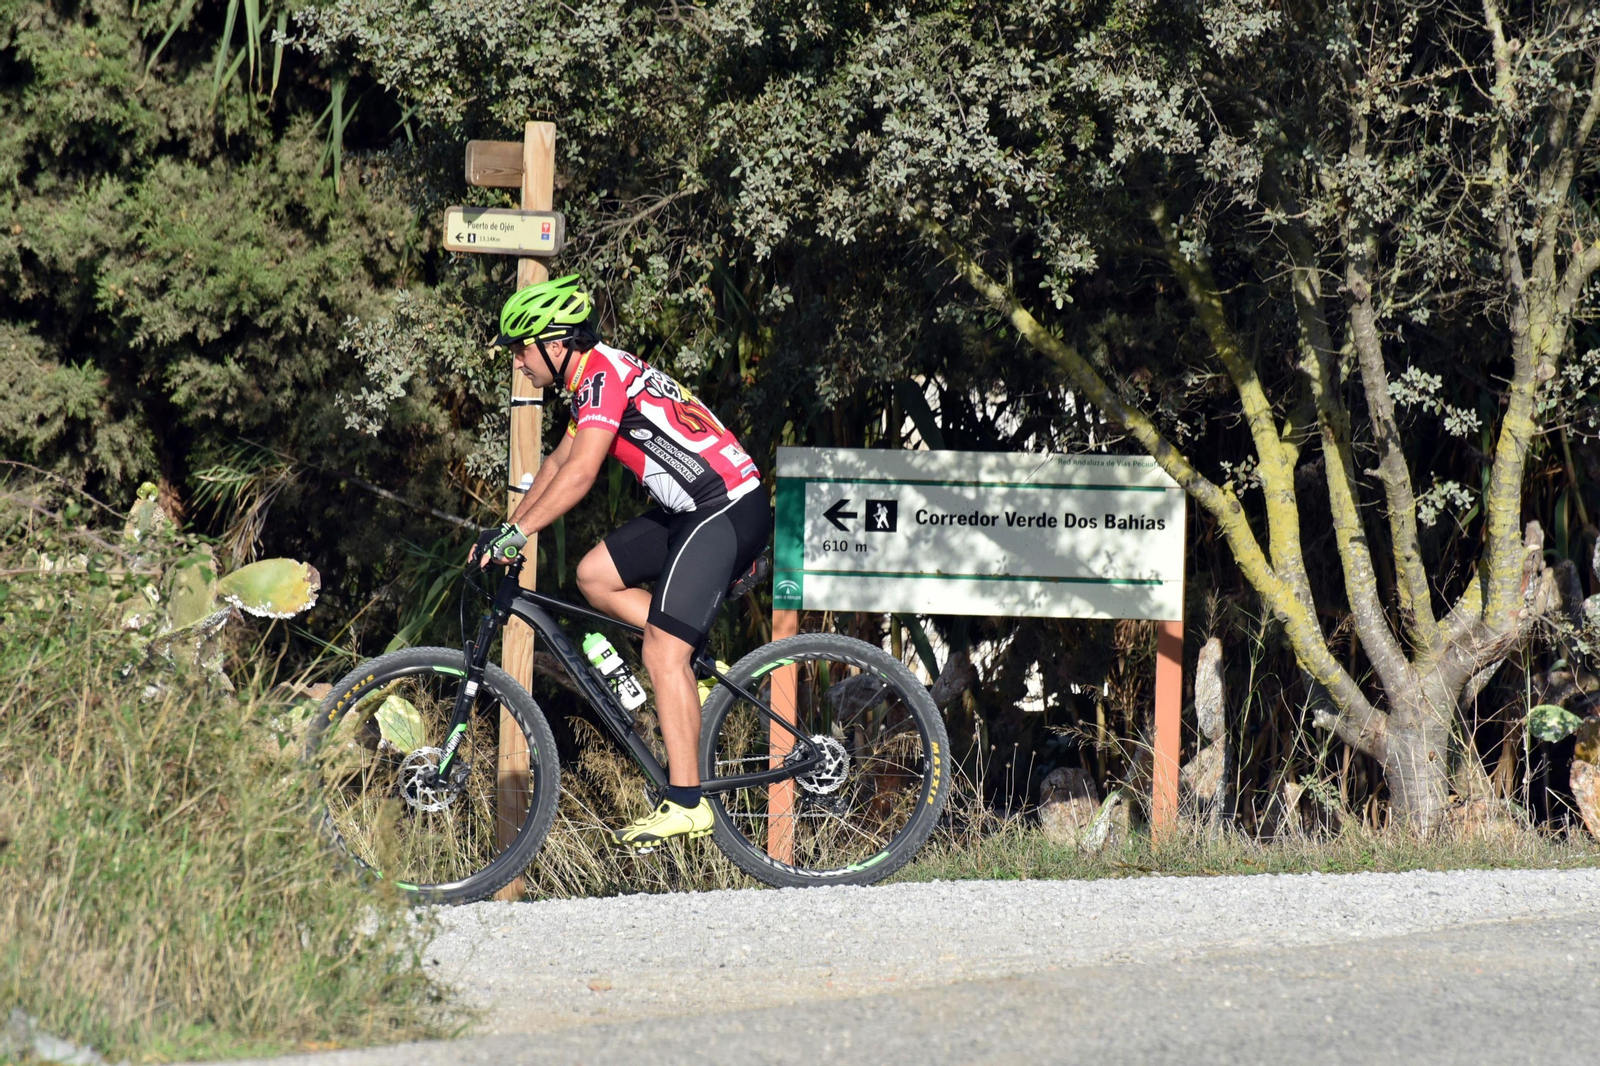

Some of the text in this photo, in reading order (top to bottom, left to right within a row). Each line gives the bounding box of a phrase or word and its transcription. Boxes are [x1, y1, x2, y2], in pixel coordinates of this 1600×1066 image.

[467, 221, 515, 232] Puerto de Ojén
[643, 440, 697, 483] INTERNACIONALE
[654, 436, 705, 476] UNION CYCLISTE
[1058, 458, 1071, 466] Red
[1073, 459, 1105, 467] Andaluza
[915, 509, 1166, 530] Corredor Verde Dos Bahías
[822, 540, 867, 552] 610 m
[328, 674, 375, 722] MAXXIS
[927, 741, 941, 805] MAXXIS
